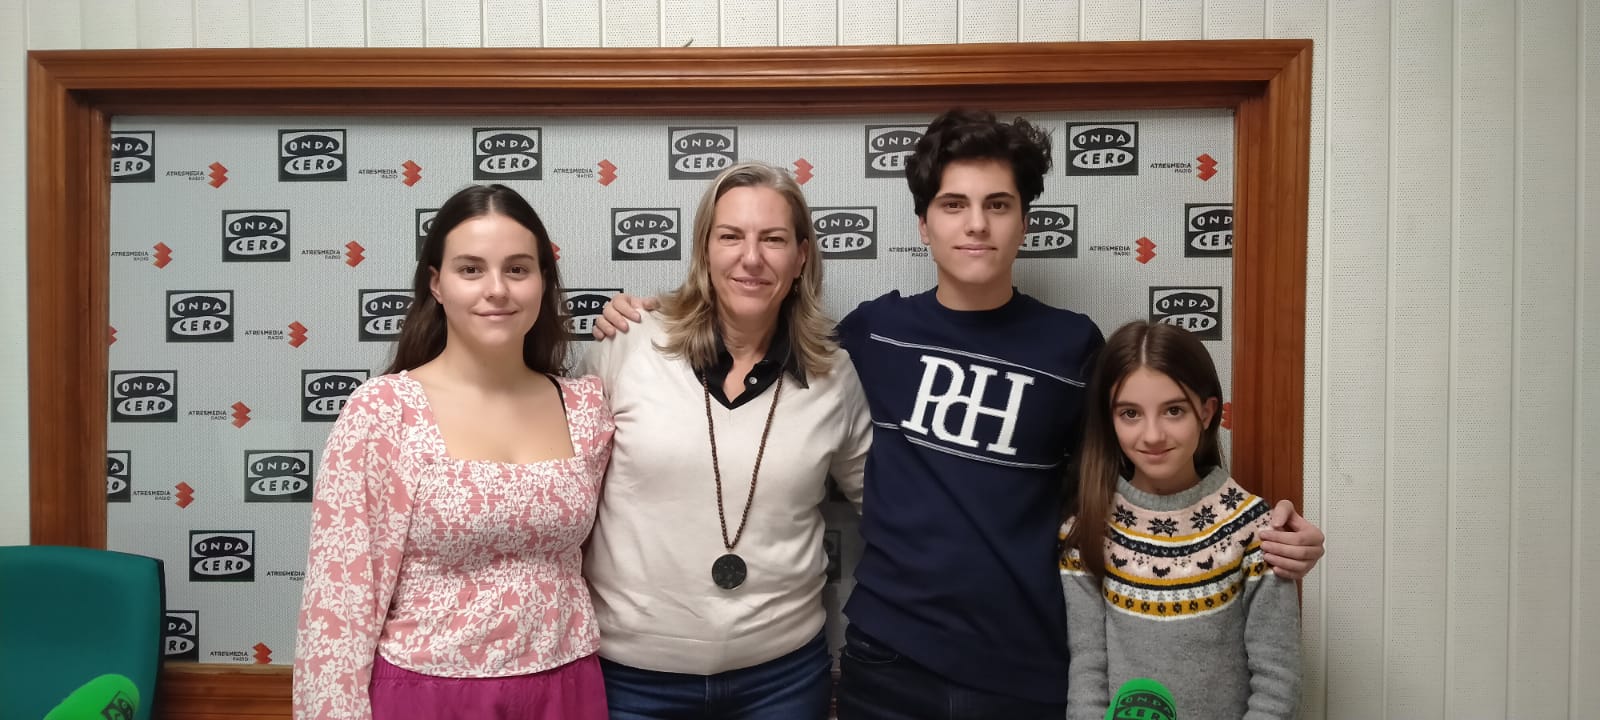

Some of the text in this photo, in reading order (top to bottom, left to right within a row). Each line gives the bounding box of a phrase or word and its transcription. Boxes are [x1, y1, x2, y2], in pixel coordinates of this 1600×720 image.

[484, 139, 529, 150] ONDA
[680, 139, 725, 149] ONDA
[1077, 134, 1126, 145] ONDA
[111, 143, 144, 151] NDA
[289, 140, 335, 151] ONDA
[292, 158, 335, 170] CERO
[487, 157, 530, 169] CERO
[682, 157, 726, 169] CERO
[1080, 152, 1126, 165] CERO
[113, 160, 144, 172] ERO
[623, 219, 668, 230] ONDA
[819, 218, 864, 229] ONDA
[1029, 216, 1064, 226] NDA
[1197, 215, 1232, 226] OND
[233, 221, 278, 232] ONDA
[236, 239, 279, 251] CERO
[625, 237, 669, 249] CERO
[821, 237, 865, 249] CERO
[1200, 235, 1232, 246] CER
[177, 301, 222, 312] ONDA
[566, 300, 609, 311] OND
[1161, 298, 1209, 310] ONDA
[179, 320, 222, 332] CERO
[372, 319, 406, 331] CER
[121, 381, 165, 393] ONDA
[313, 381, 357, 392] ONDA
[124, 399, 166, 412] CERO
[315, 399, 348, 411] CE
[255, 462, 301, 472] ONDA
[258, 480, 301, 491] CERO
[199, 541, 244, 552] ONDA
[202, 560, 244, 571] CERO
[167, 622, 187, 631] DA
[169, 640, 187, 651] RO
[1126, 697, 1171, 714] ONDA
